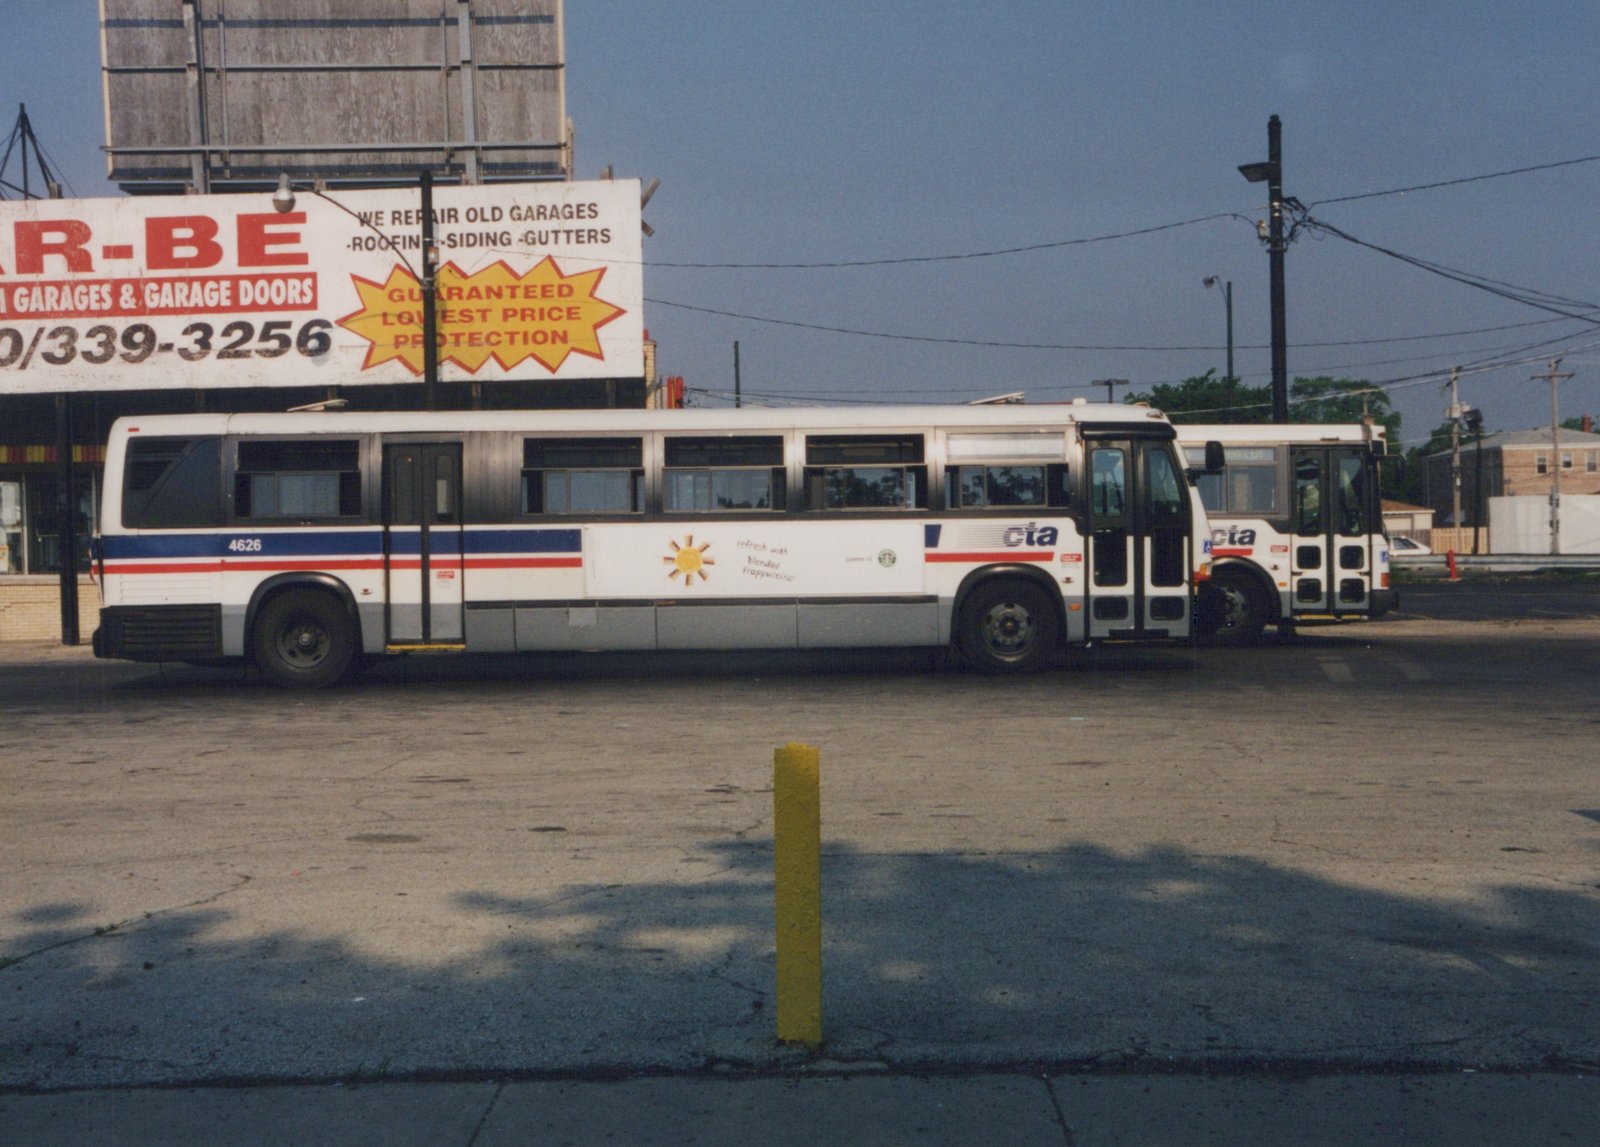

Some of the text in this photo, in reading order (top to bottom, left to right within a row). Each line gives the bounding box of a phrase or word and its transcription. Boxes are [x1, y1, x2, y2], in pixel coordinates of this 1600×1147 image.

[358, 202, 599, 226] WE REPAIR OLD GARAGES
[0, 211, 309, 275] R-BE
[347, 228, 611, 252] -ROOFIN -SIDING -GUTTERS
[13, 283, 113, 313] GARAGES
[119, 283, 137, 309] &
[144, 280, 232, 309] GARAGE
[238, 277, 314, 307] DOORS
[387, 284, 574, 303] GUARANTEED
[502, 306, 582, 323] PRICE
[394, 330, 569, 349] PROTECTION
[1003, 522, 1059, 547] cta
[1211, 525, 1257, 546] cta
[228, 538, 262, 552] 4626
[736, 539, 788, 556] refresh with
[747, 555, 781, 570] blended
